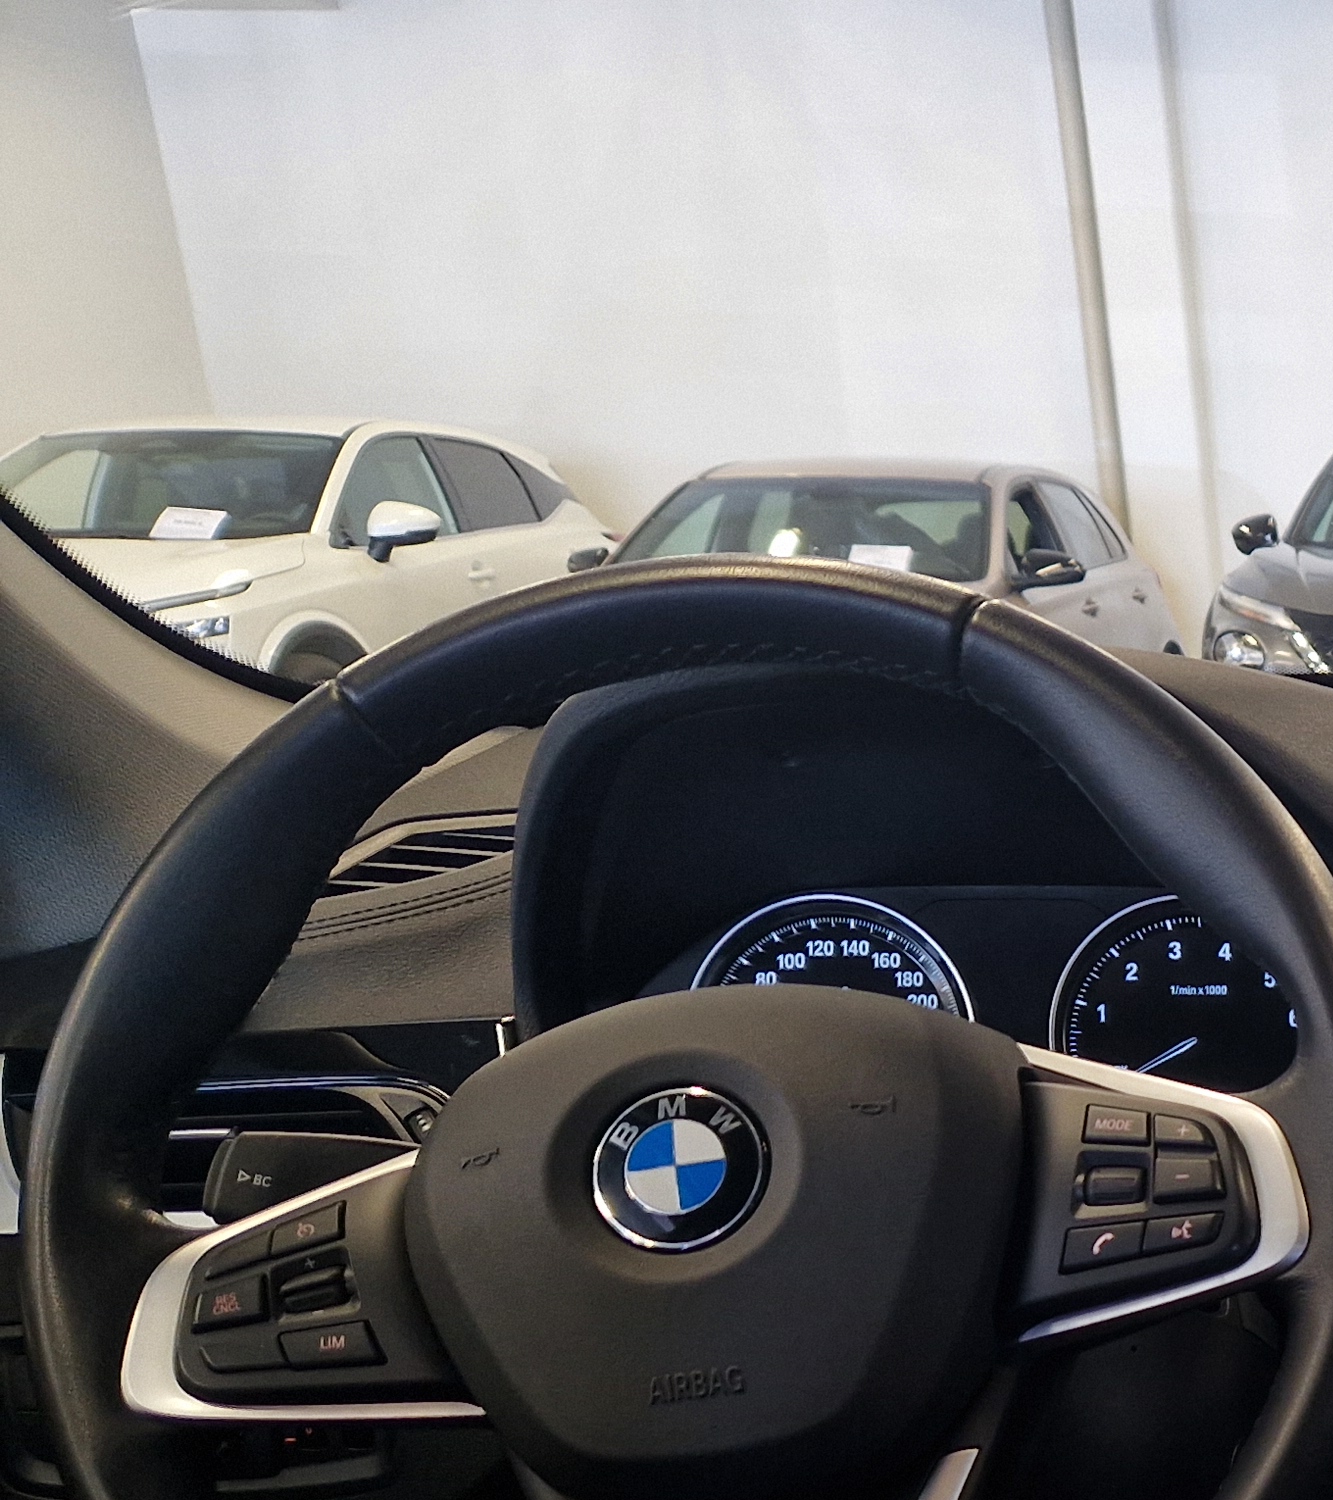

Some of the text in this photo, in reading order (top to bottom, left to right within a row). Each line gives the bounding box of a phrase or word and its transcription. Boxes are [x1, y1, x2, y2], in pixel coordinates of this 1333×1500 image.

[806, 940, 834, 957] 120
[840, 940, 870, 957] 140
[1167, 941, 1182, 960] 3
[1218, 942, 1233, 962] 4
[776, 953, 806, 970] 100
[871, 953, 901, 969] 160
[755, 972, 778, 986] 80
[894, 972, 923, 988] 180
[1125, 962, 1139, 981] 2
[1264, 971, 1277, 988] 5
[1205, 985, 1228, 995] 1000
[1096, 1003, 1106, 1023] 1
[609, 1095, 742, 1151] BMW
[1094, 1118, 1133, 1131] MODE
[253, 1173, 272, 1187] BC
[319, 1335, 346, 1350] LIM
[649, 1365, 745, 1405] AIRBAG
